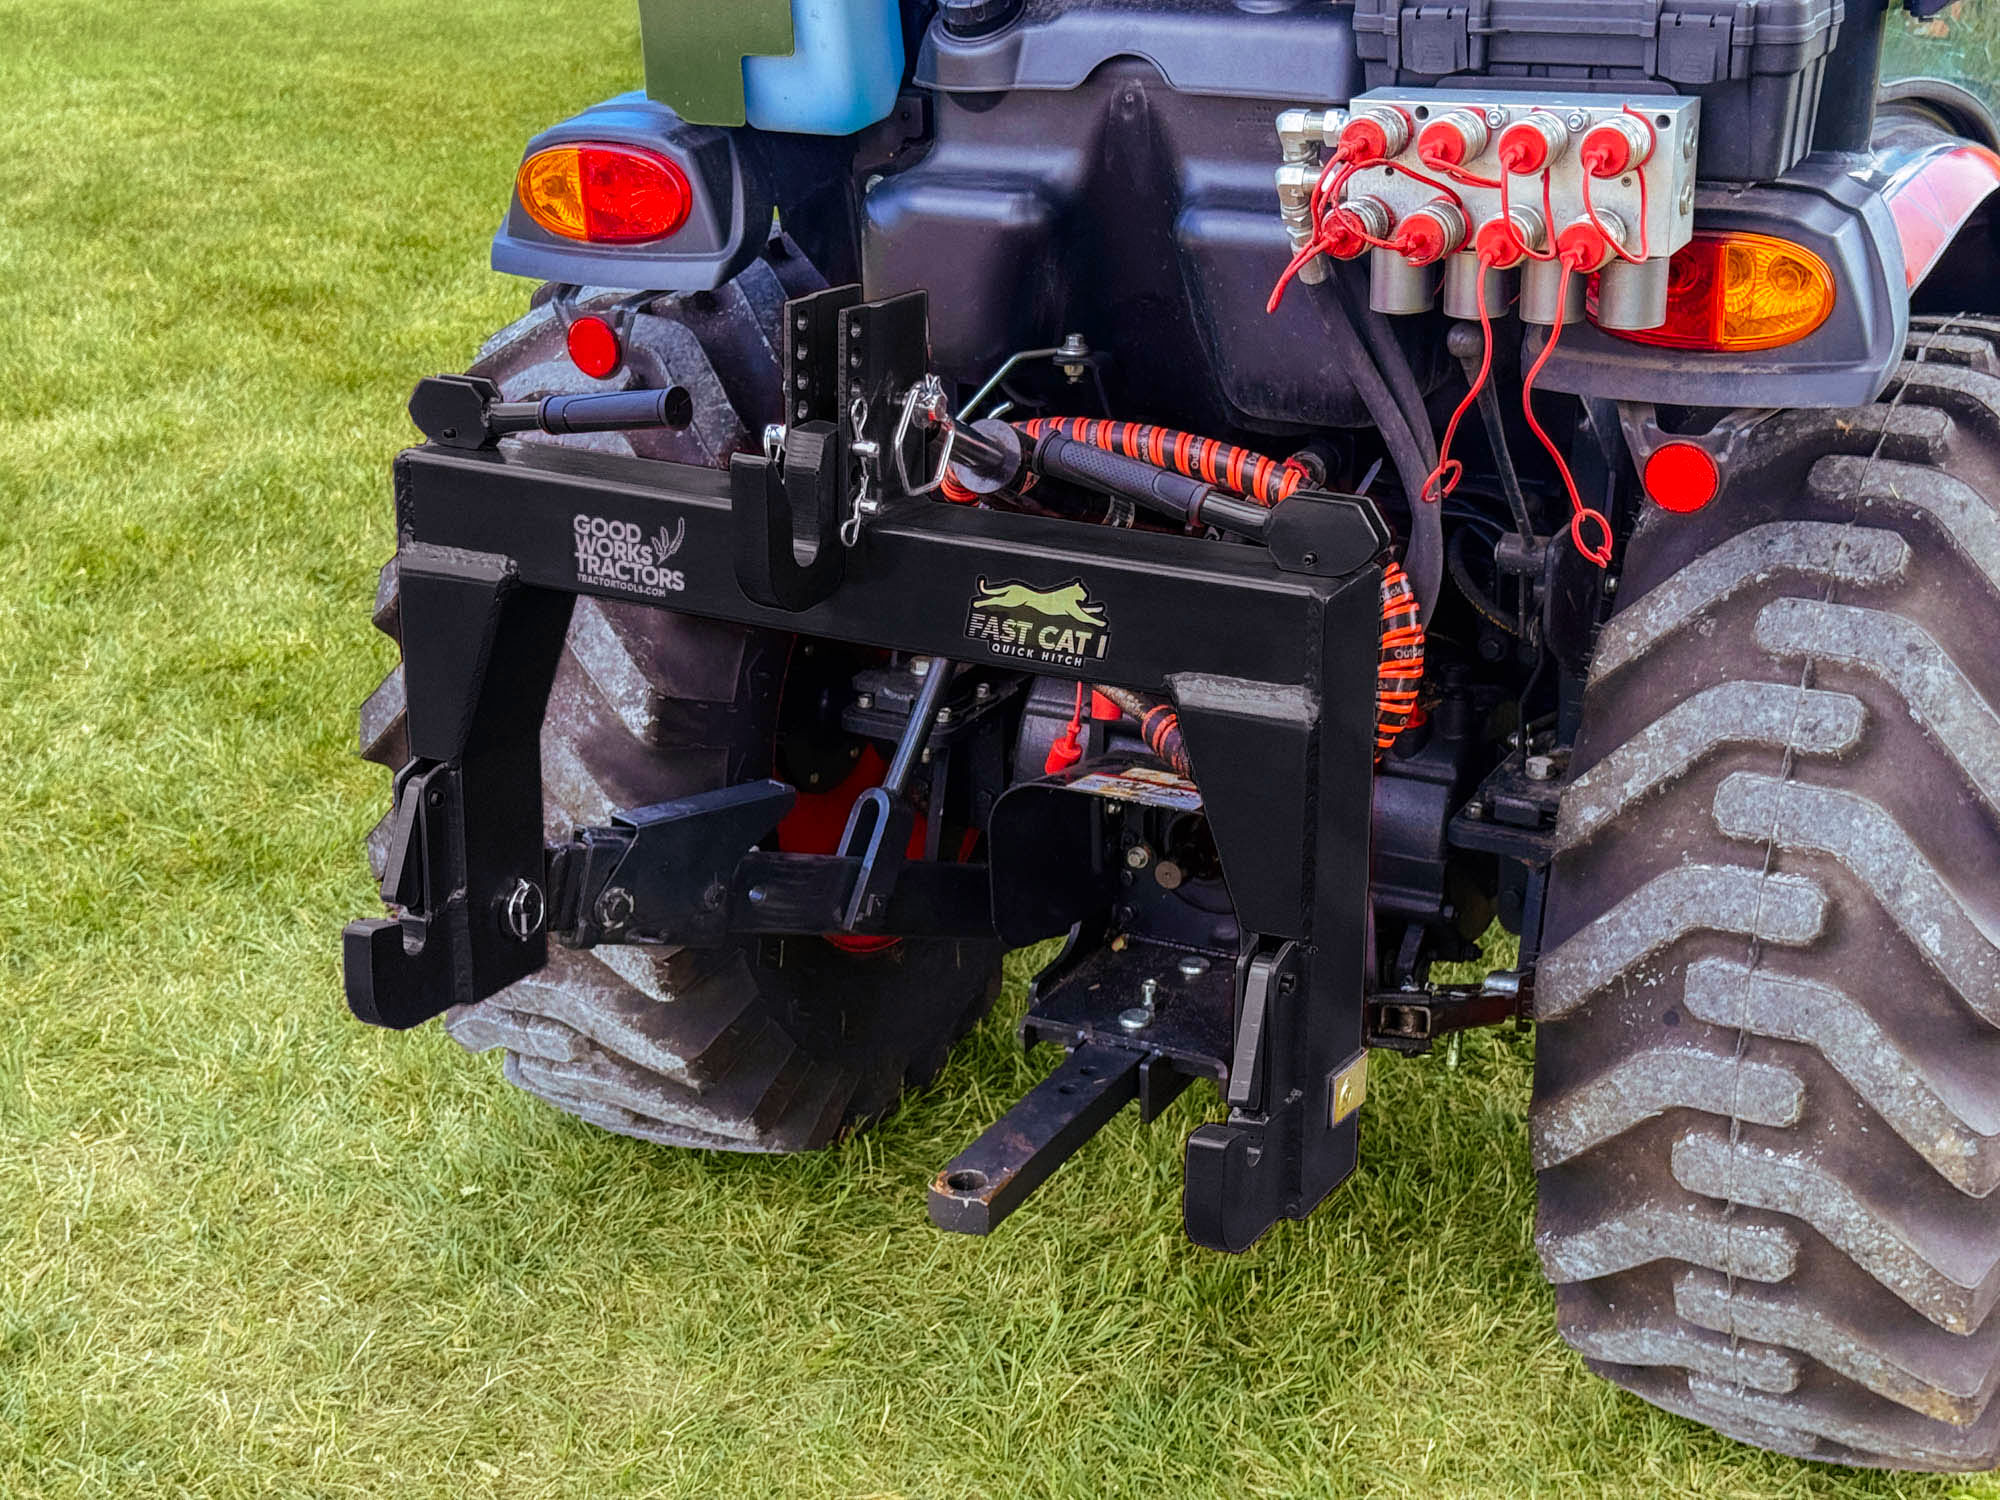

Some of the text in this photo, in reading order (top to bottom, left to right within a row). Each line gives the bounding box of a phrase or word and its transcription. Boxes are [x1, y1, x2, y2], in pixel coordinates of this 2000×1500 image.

[573, 514, 642, 544] GOOD
[574, 532, 654, 566] WORKS
[574, 551, 686, 592] TRACTORS
[577, 573, 667, 598] TRACTORTOOLS.COM
[967, 612, 1034, 646] FAST
[1037, 625, 1093, 656] CAT
[991, 643, 1083, 667] QUICK HITCH
